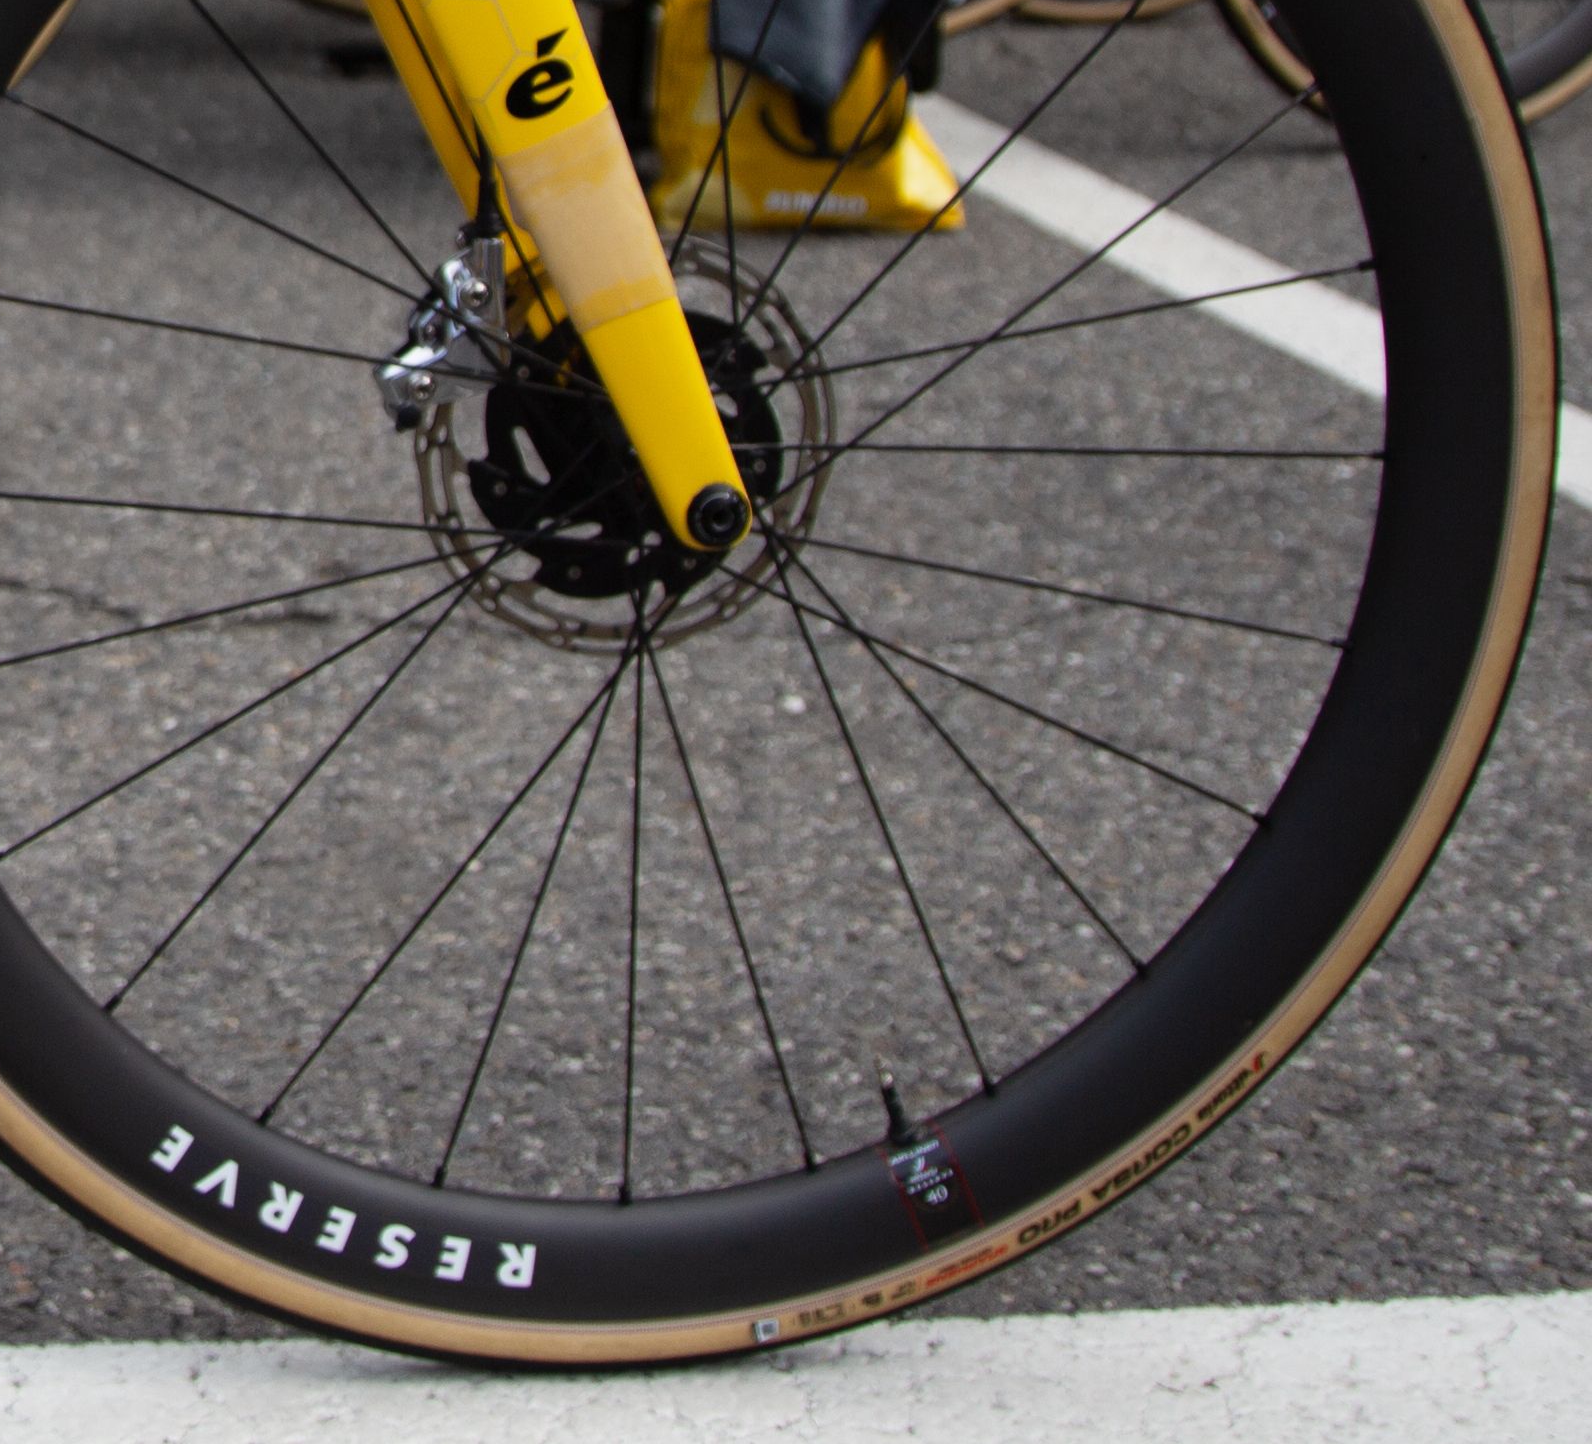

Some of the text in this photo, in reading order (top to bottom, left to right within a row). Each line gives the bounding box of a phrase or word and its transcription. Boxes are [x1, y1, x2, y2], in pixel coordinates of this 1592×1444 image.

[1091, 1122, 1192, 1201] CORSA
[150, 1124, 537, 1288] RESERVE
[1018, 1199, 1083, 1245] PRO
